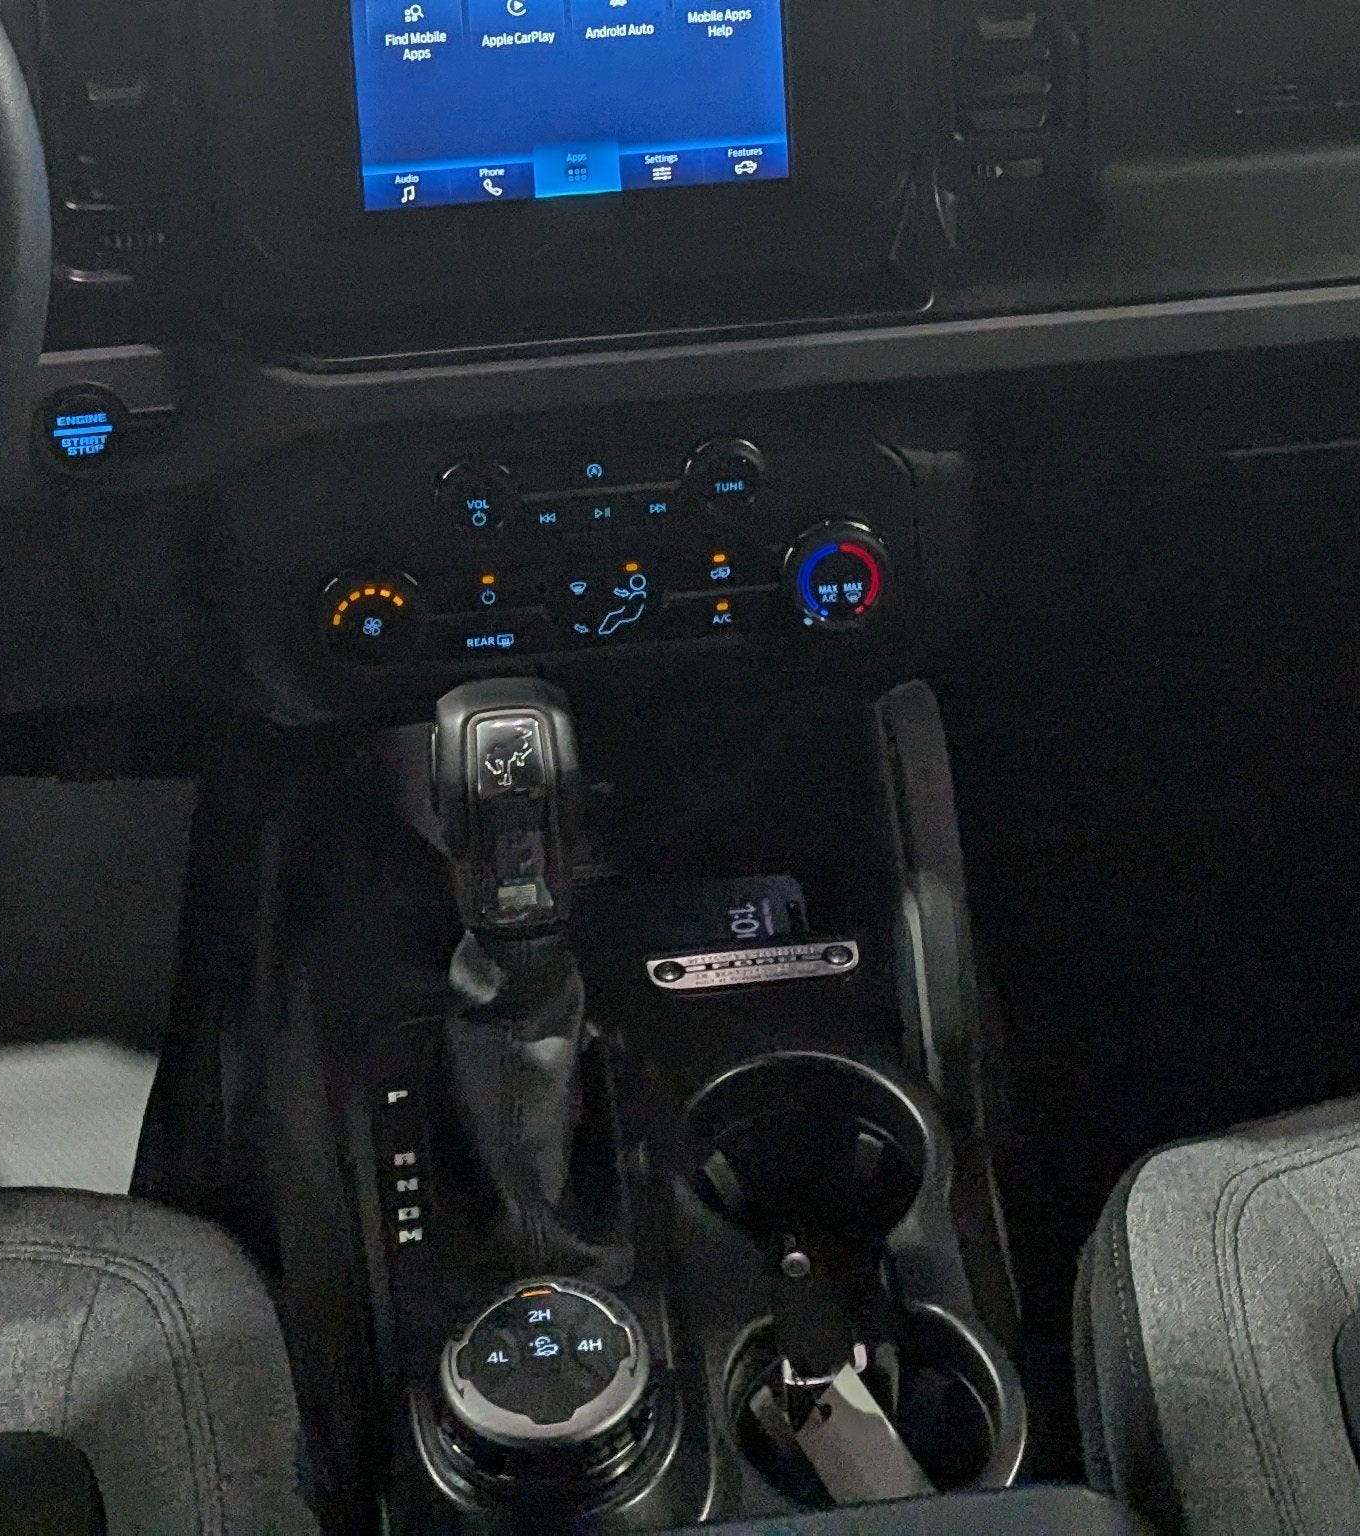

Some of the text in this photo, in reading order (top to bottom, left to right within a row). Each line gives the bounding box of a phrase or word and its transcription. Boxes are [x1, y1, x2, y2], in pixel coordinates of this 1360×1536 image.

[687, 8, 752, 23] Mobile Apps
[585, 23, 654, 39] Android Auto
[708, 25, 733, 38] Help
[385, 31, 447, 46] Find Mobile
[481, 31, 555, 48] Apple CarPlay
[403, 48, 431, 61] Apps
[566, 151, 587, 163] Apps
[644, 152, 678, 165] Settings
[727, 146, 763, 159] Features
[394, 173, 420, 184] Audio
[479, 166, 505, 178] Phone
[56, 413, 107, 426] ENGINE
[61, 435, 107, 448] START
[67, 444, 104, 456] STOP
[714, 480, 745, 493] TUNE
[466, 499, 490, 510] VOL
[818, 584, 838, 594] MAX
[843, 582, 863, 592] MAX
[822, 594, 837, 603] A/C
[712, 613, 732, 624] A/C
[466, 636, 495, 647] REAR
[528, 1308, 551, 1323] 2H
[577, 1338, 603, 1352] 4H
[487, 1350, 509, 1364] 4L
